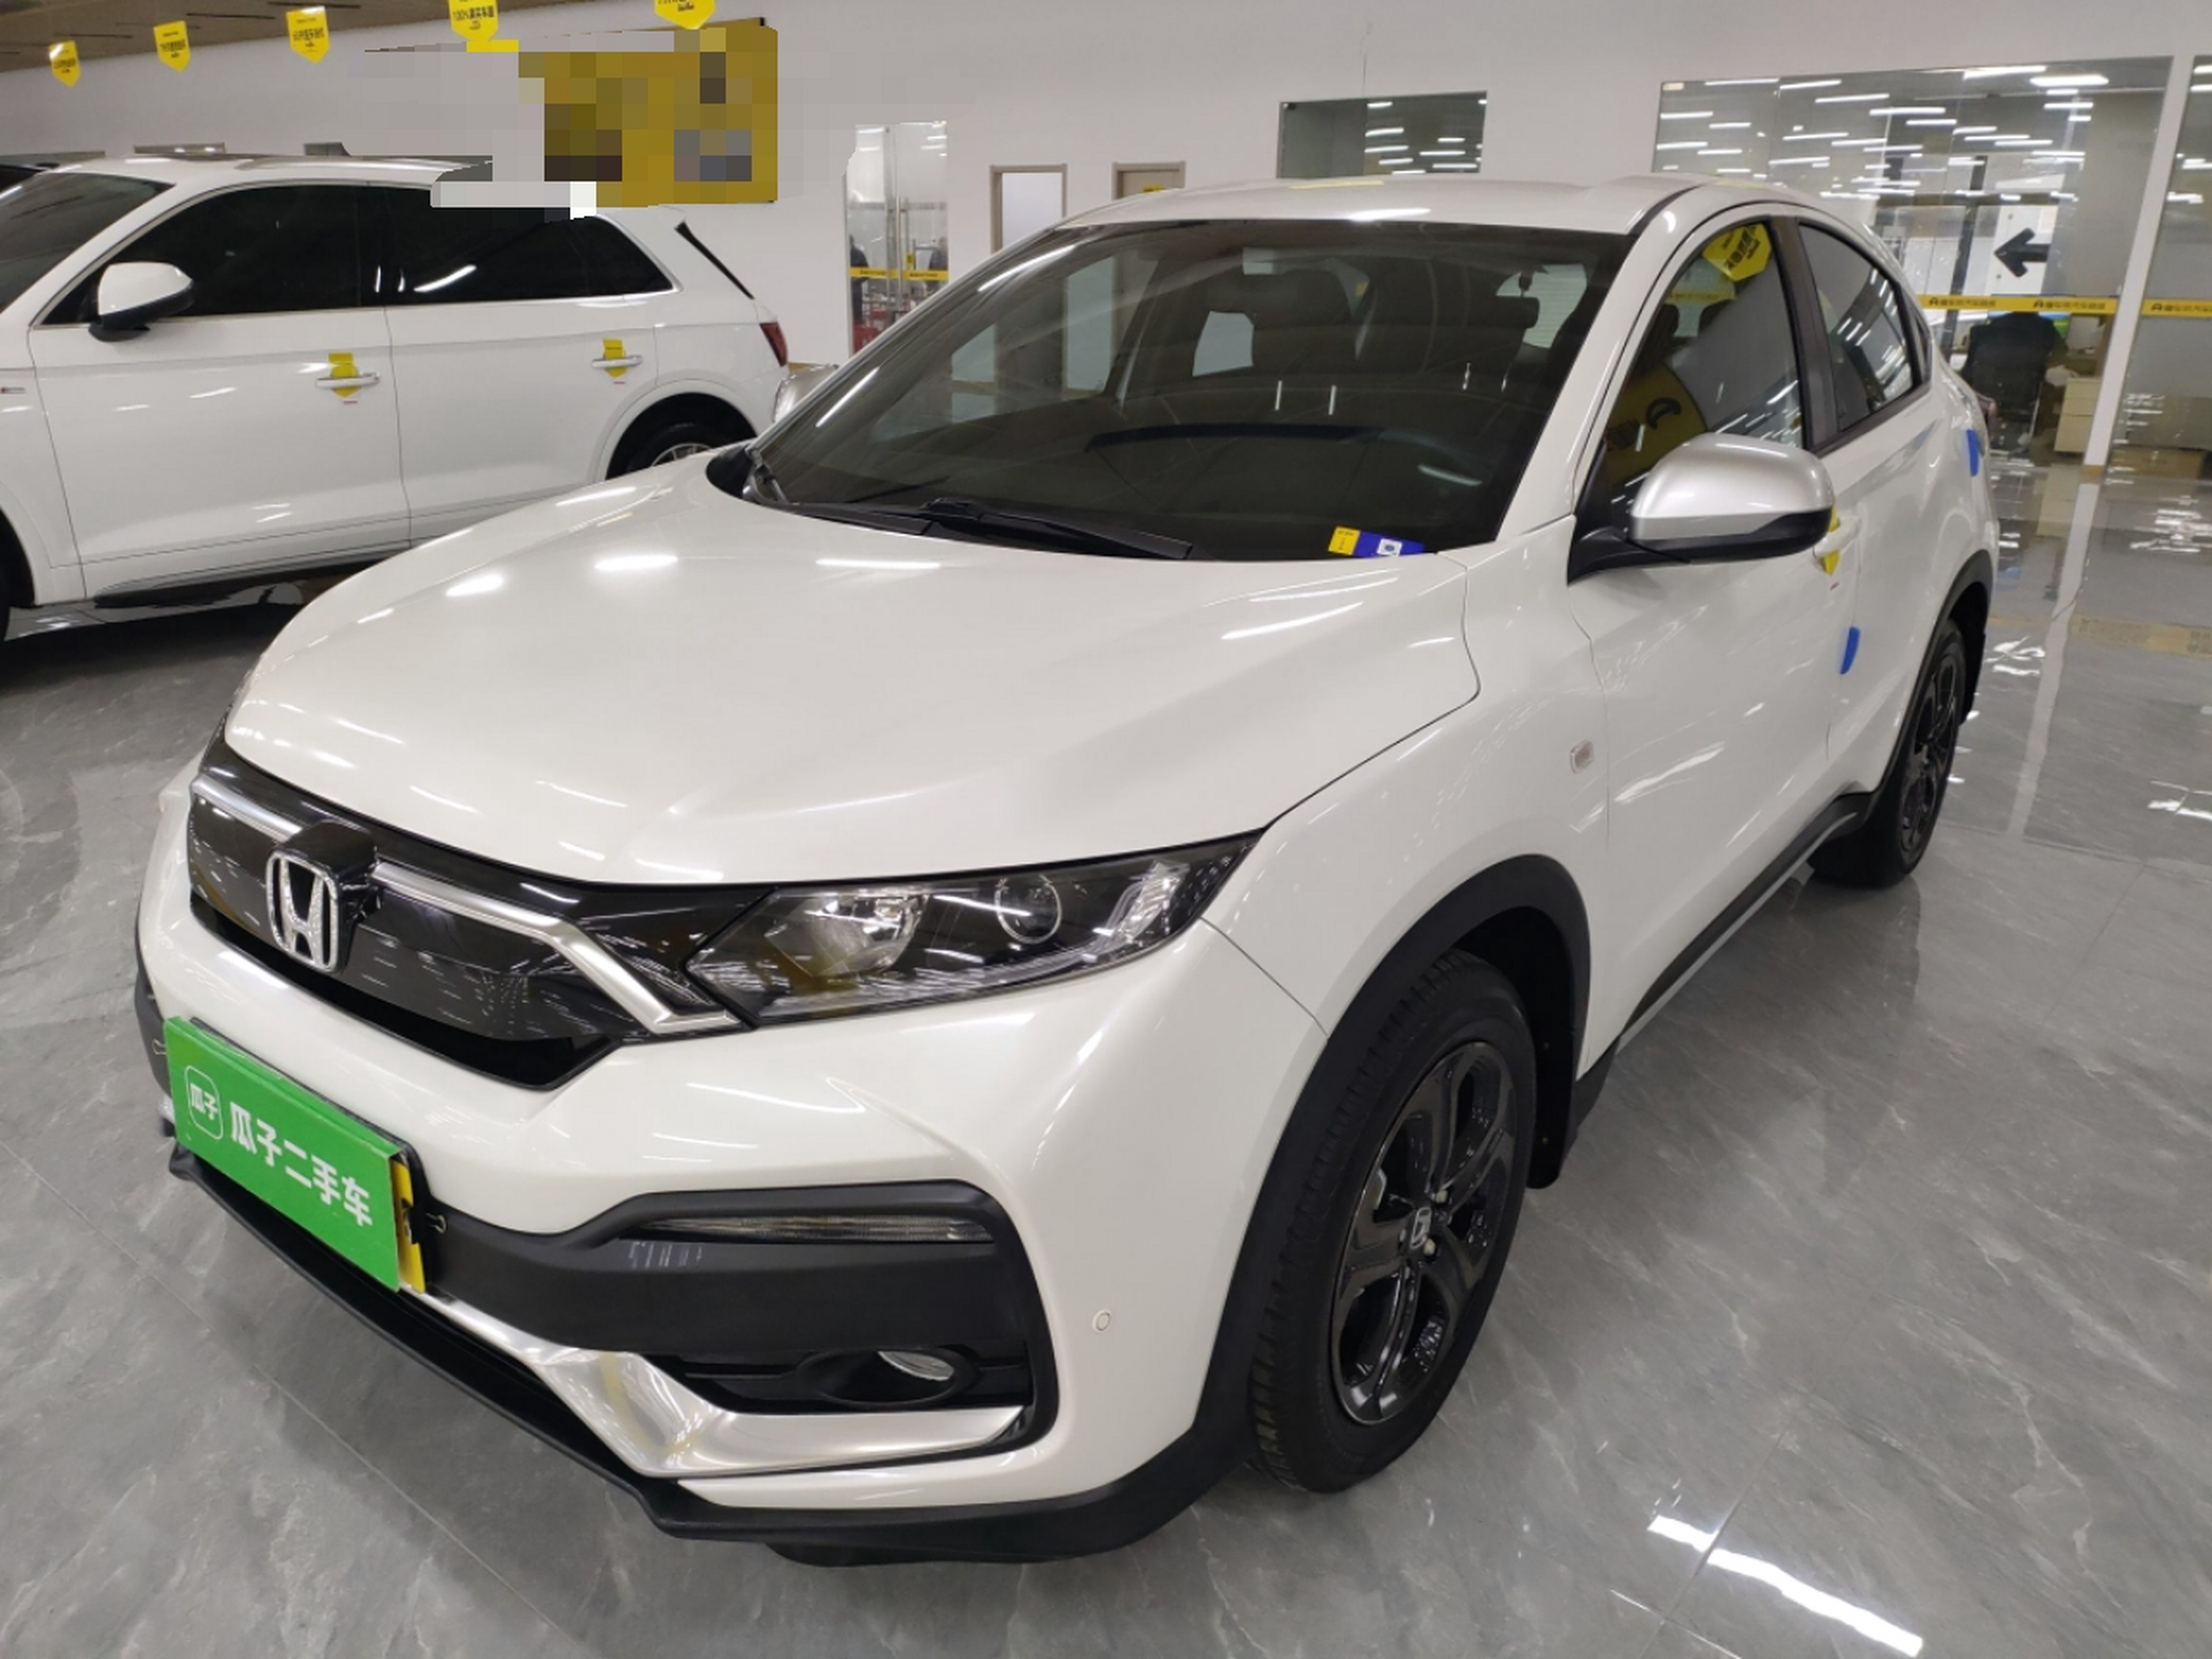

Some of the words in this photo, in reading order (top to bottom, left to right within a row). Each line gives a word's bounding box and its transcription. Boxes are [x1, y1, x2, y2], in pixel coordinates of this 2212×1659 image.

[190, 1082, 218, 1120] 瓜子
[230, 1101, 374, 1227] 瓜子二手车
